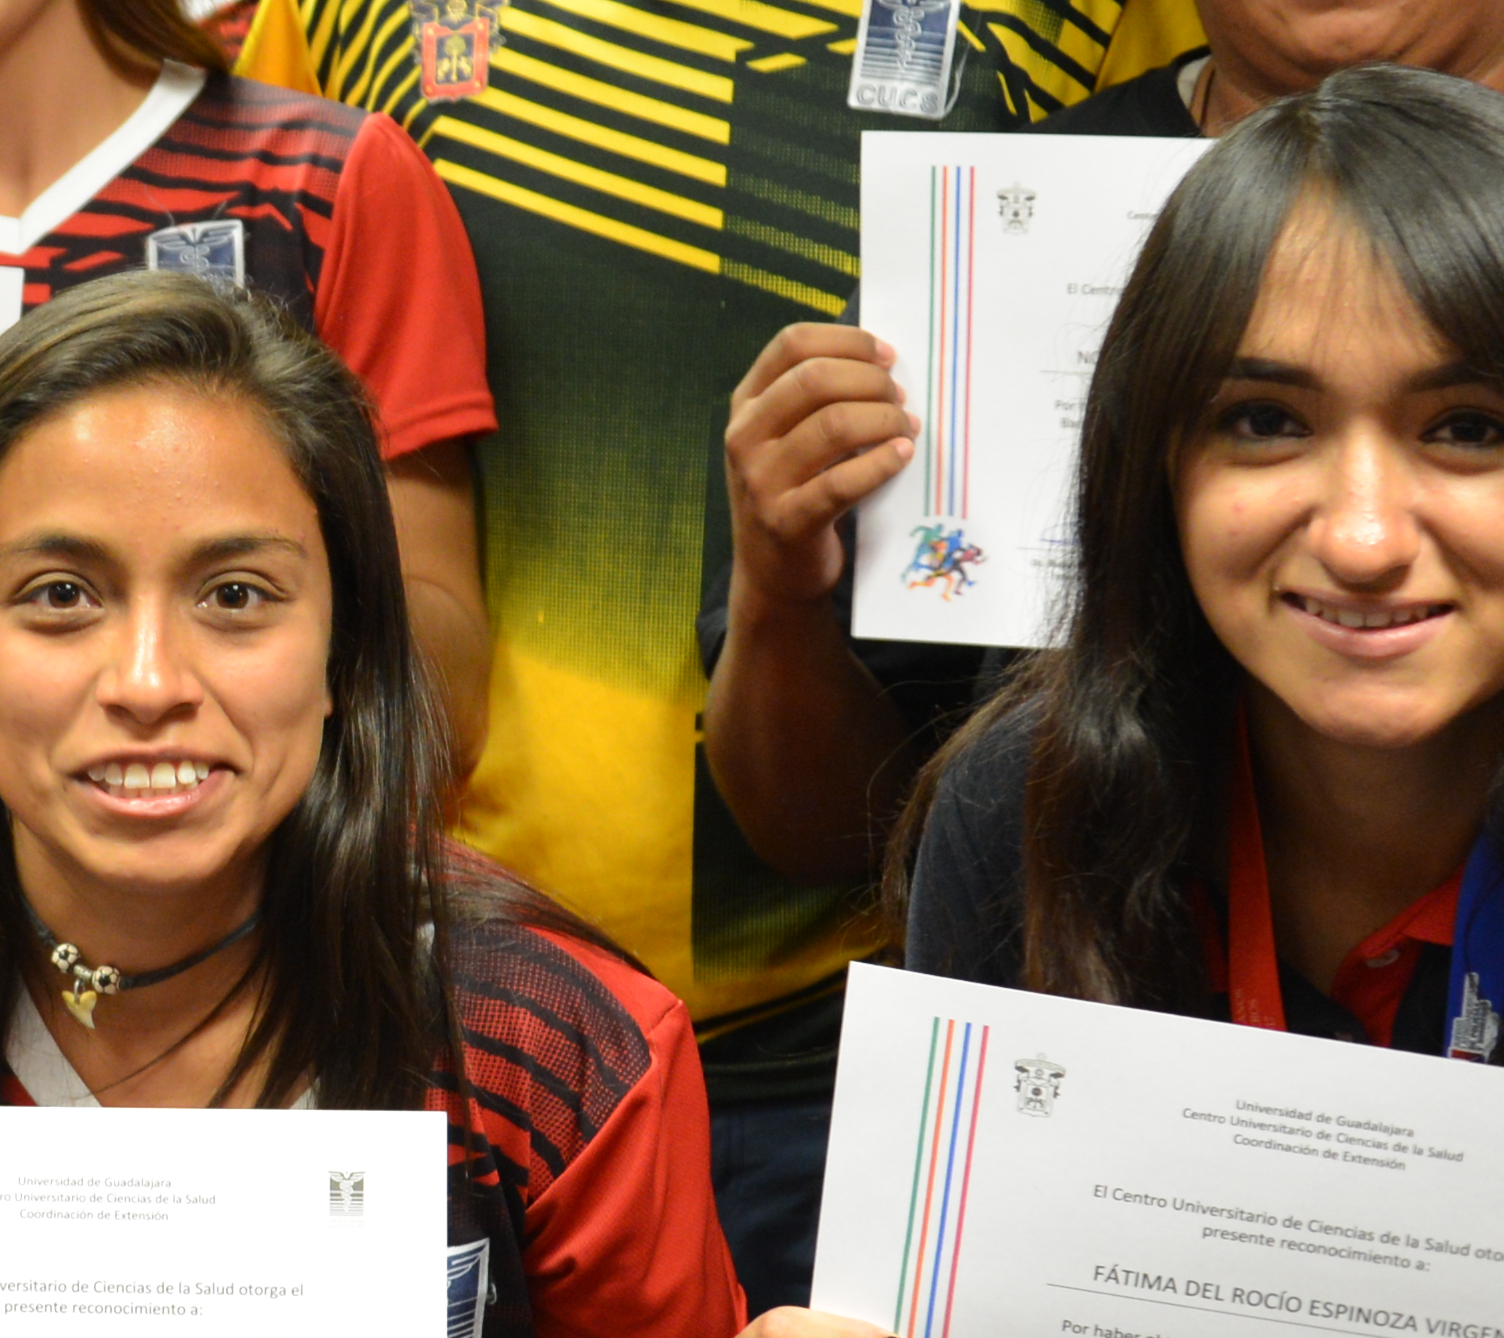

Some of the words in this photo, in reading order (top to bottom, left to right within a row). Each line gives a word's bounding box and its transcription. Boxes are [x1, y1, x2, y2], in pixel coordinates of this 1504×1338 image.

[856, 83, 938, 115] CUCS
[17, 1176, 84, 1187] Universidad
[86, 1176, 101, 1187] de
[103, 1177, 172, 1190] Guadalajara
[14, 1192, 86, 1203] Universitario
[88, 1192, 103, 1203] de
[105, 1193, 152, 1204] Ciencias
[154, 1193, 169, 1204] de
[172, 1193, 182, 1204] la
[185, 1194, 216, 1205] Salud
[19, 1208, 94, 1220] Coordinación
[96, 1209, 111, 1220] de
[114, 1209, 169, 1221] Extensión
[1092, 1183, 1108, 1198] El
[1111, 1187, 1168, 1208] Centro
[1171, 1197, 1278, 1226] Universitario
[1280, 1215, 1303, 1231] de
[1306, 1219, 1375, 1242] Ciencias
[1378, 1230, 1401, 1246] de
[1403, 1233, 1420, 1249] la
[1423, 1237, 1471, 1257] Salud
[1201, 1226, 1275, 1247] presente
[1279, 1238, 1411, 1268] reconocimiento
[1413, 1259, 1431, 1272] a:
[71, 1279, 89, 1293] de
[93, 1280, 152, 1294] Ciencias
[155, 1281, 174, 1295] de
[178, 1281, 191, 1295] la
[195, 1282, 234, 1295] Salud
[238, 1284, 287, 1299] otorga
[290, 1283, 303, 1297] el
[1093, 1263, 1177, 1294] FÁTIMA
[1183, 1279, 1224, 1302] DEL
[1231, 1286, 1302, 1313] ROCÍO
[1308, 1299, 1417, 1331] ESPINOZA
[4, 1302, 68, 1315] presente
[72, 1302, 186, 1315] reconocimiento
[189, 1305, 203, 1316] a:
[1061, 1319, 1090, 1335] Por
